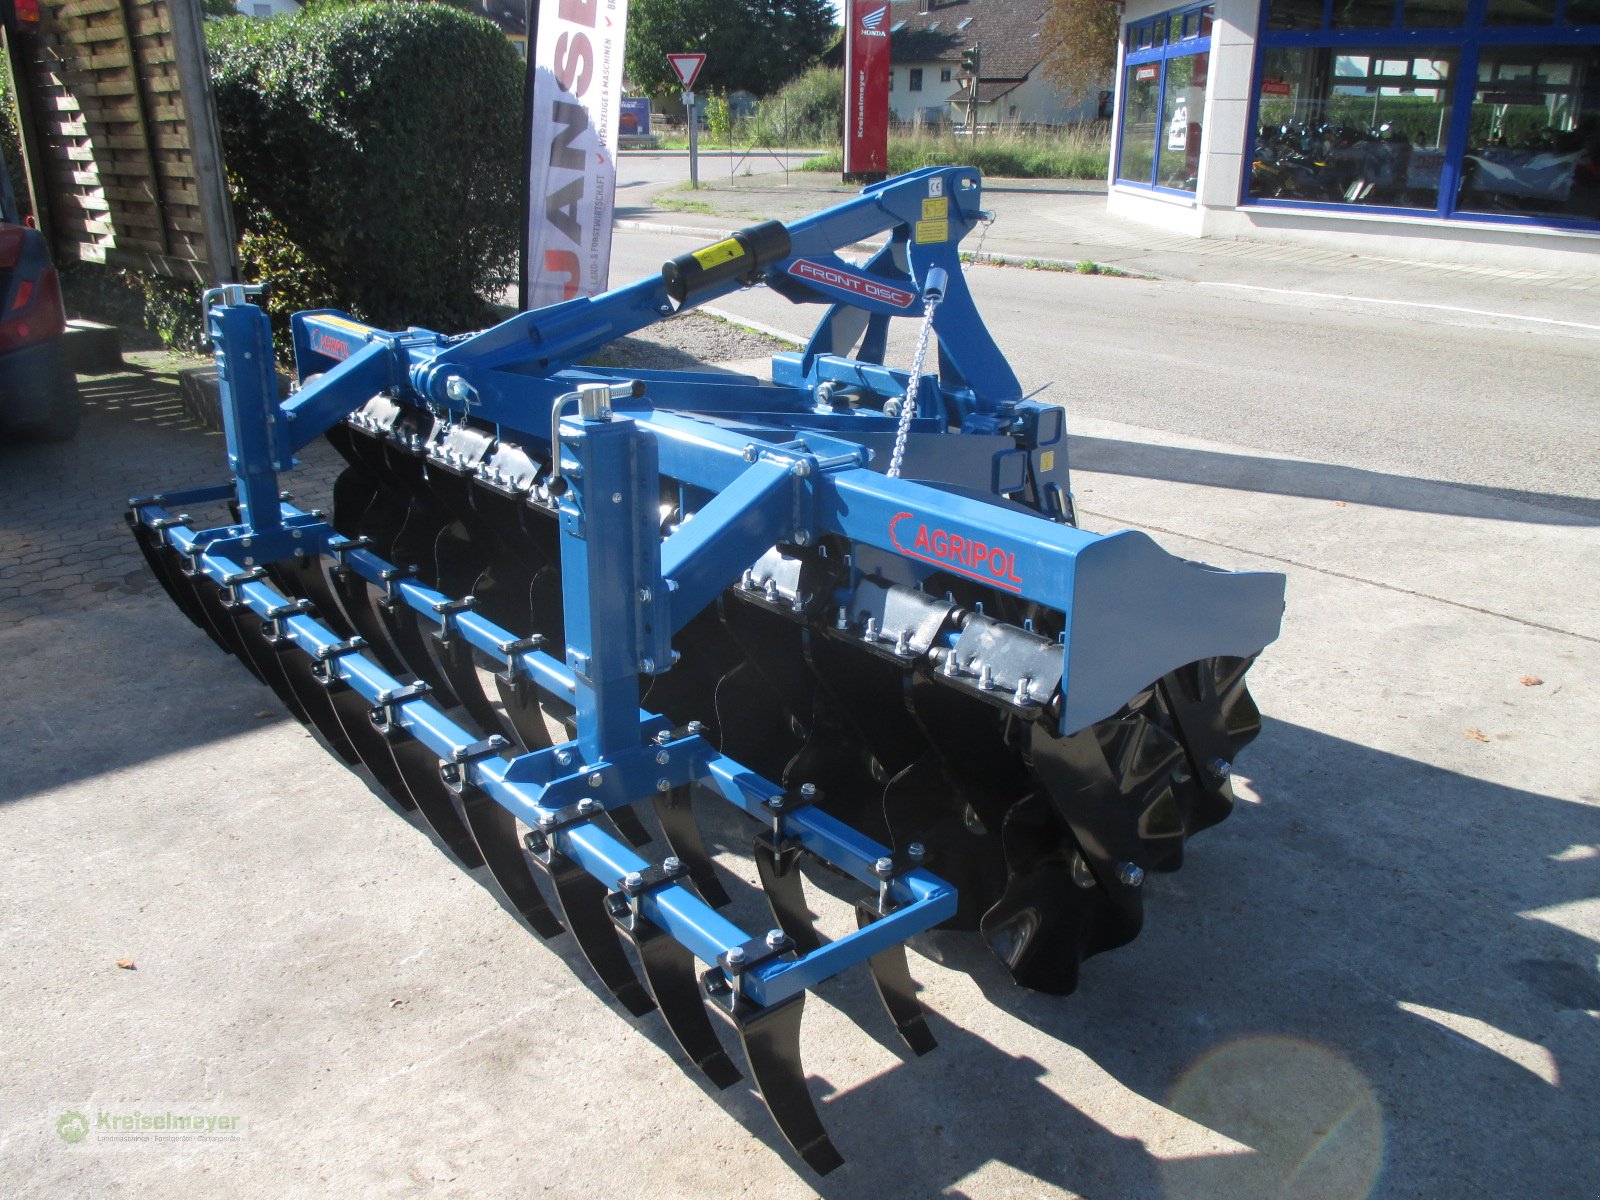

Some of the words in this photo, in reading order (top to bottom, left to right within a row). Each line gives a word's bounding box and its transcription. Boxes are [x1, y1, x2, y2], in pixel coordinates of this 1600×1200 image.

[861, 29, 886, 37] HONDA
[602, 38, 612, 88] MASCHINEN
[599, 97, 609, 147] WERKZEUGE
[590, 174, 605, 252] FORSTWIRTSCHAFT
[800, 264, 860, 290] FRONT
[865, 285, 904, 303] DISC
[914, 523, 1023, 584] AGRIPOL
